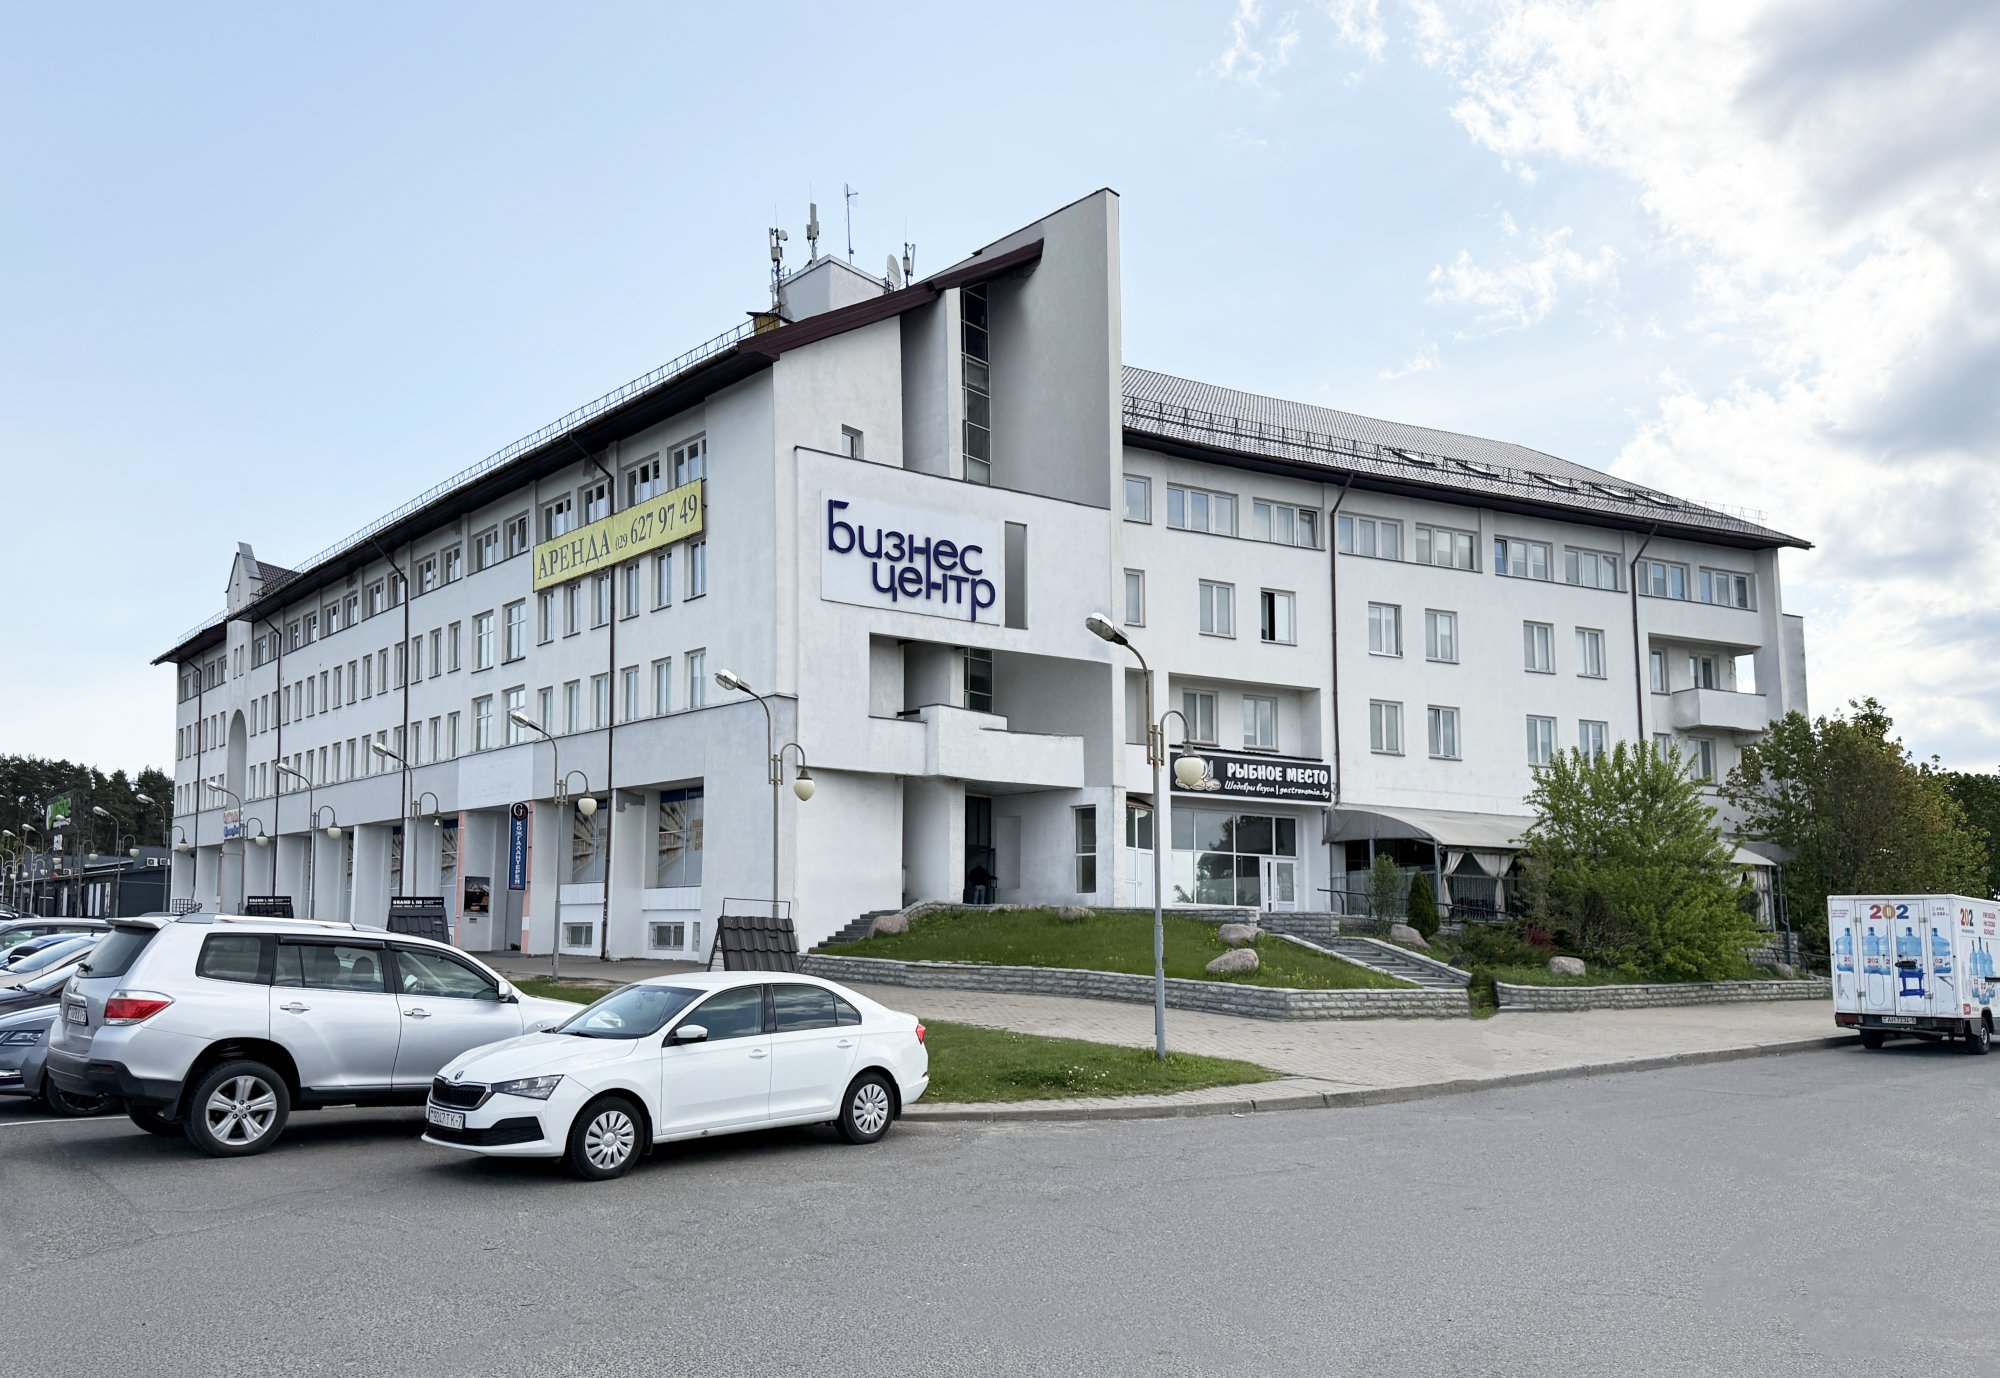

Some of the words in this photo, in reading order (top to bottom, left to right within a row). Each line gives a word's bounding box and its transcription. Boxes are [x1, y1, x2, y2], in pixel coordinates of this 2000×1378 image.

[538, 529, 611, 580] АРЕНДА
[630, 511, 654, 545] 627
[658, 503, 675, 535] 97
[679, 494, 698, 524] 49
[872, 558, 996, 622] центр
[1226, 763, 1283, 781] РЫБНОЕ
[1286, 767, 1329, 785] МЕСТО
[1869, 904, 1909, 919] 202
[1960, 908, 1974, 926] 202
